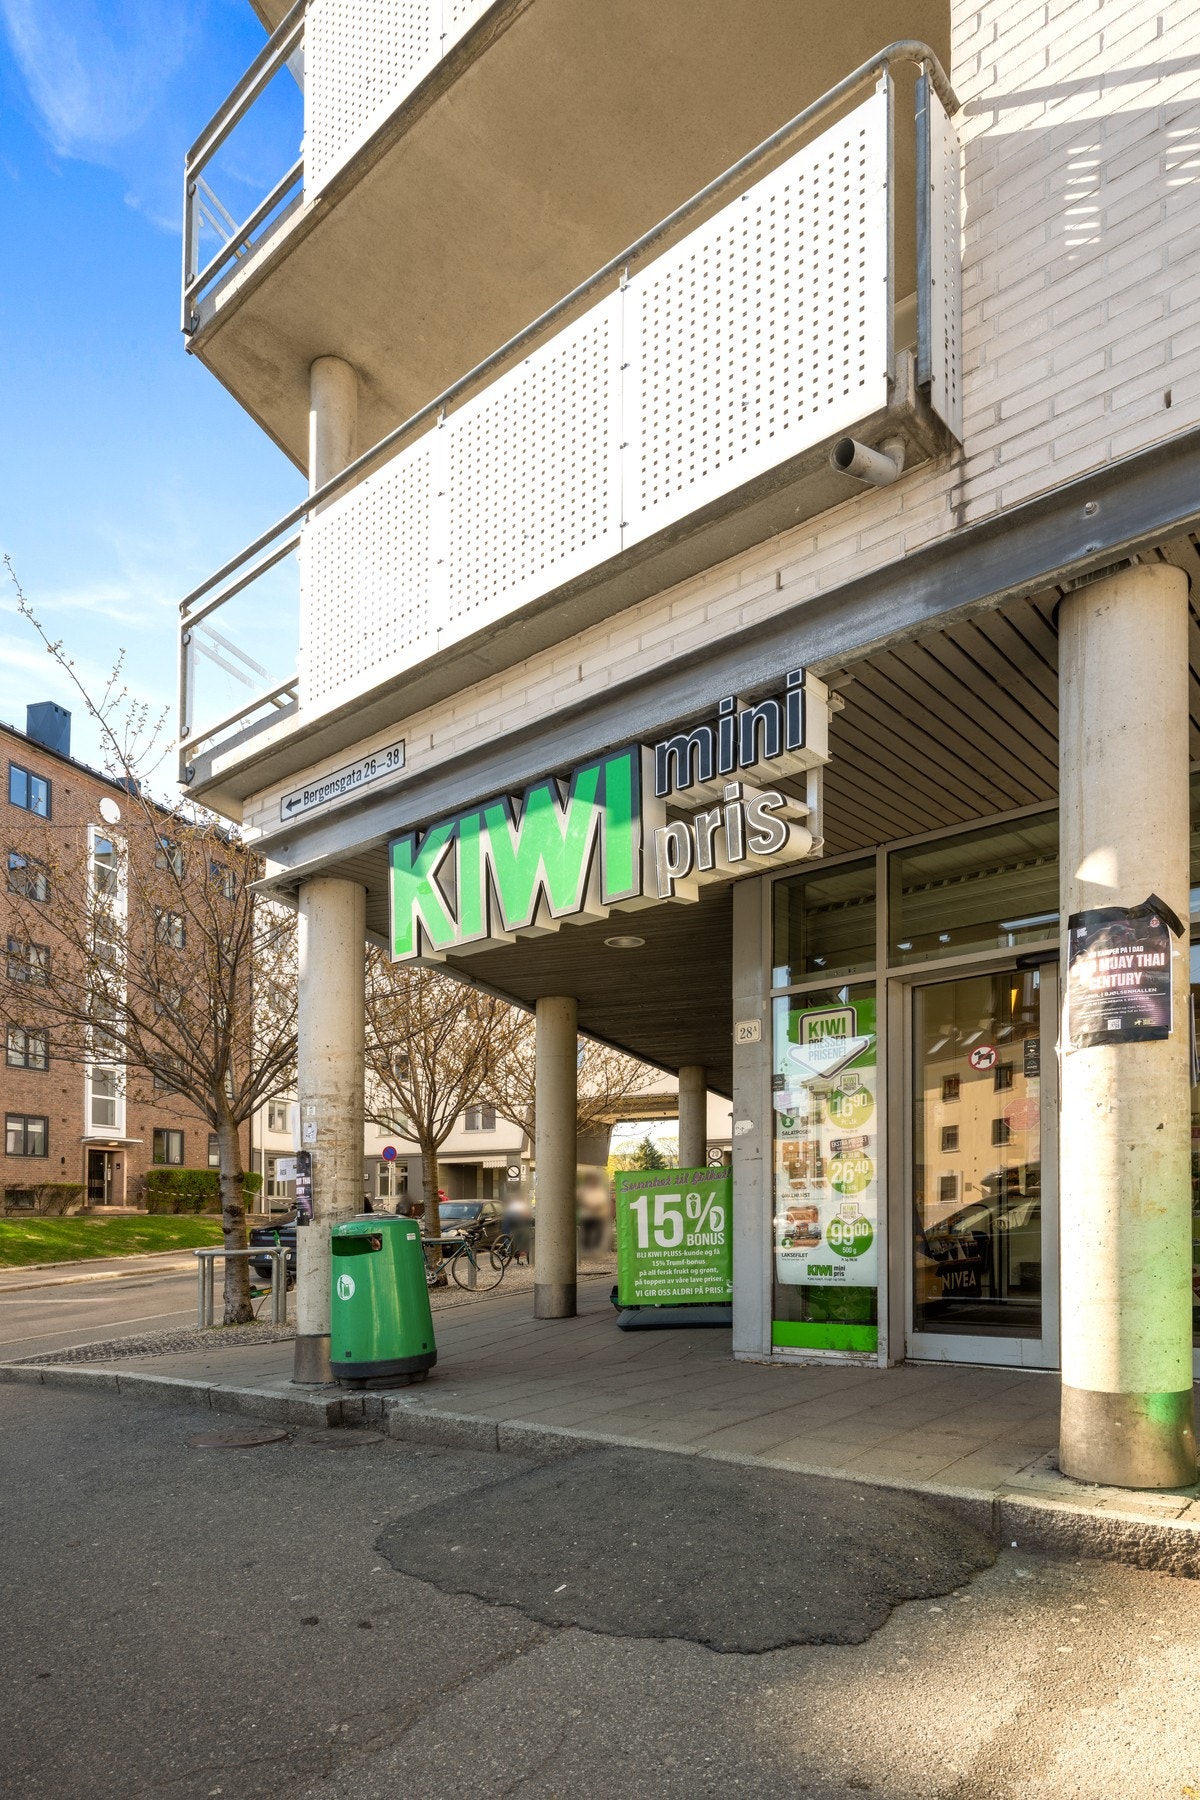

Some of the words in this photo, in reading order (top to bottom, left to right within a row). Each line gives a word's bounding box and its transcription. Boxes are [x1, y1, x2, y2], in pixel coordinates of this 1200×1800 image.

[654, 667, 806, 799] mini
[303, 769, 363, 806] Bergensgata
[653, 780, 790, 899] pris
[388, 743, 642, 964] KIWI
[1098, 954, 1135, 972] MUAY
[1136, 952, 1165, 967] THAI
[808, 1017, 846, 1038] KIWI
[808, 1035, 846, 1049] PRESSER
[674, 1172, 690, 1185] til
[629, 1191, 725, 1249] 15%
[686, 1232, 725, 1247] BONUS
[636, 1251, 647, 1259] BLI
[663, 1249, 703, 1257] PLUSS-kunde
[842, 1246, 852, 1254] 500
[639, 1270, 648, 1278] på
[656, 1268, 673, 1276] fersk
[673, 1267, 690, 1275] frukt
[690, 1268, 699, 1276] og
[807, 1264, 833, 1277] KIWI
[634, 1279, 643, 1287] på
[643, 1277, 666, 1286] toppen
[675, 1276, 689, 1284] våre
[690, 1276, 703, 1284] lave
[942, 1269, 977, 1291] NIVEA
[644, 1289, 657, 1297] GIR
[657, 1288, 671, 1296] OSS
[672, 1287, 693, 1296] ALDRI
[694, 1285, 704, 1295] PÅ
[705, 1286, 724, 1294] PRIS!
